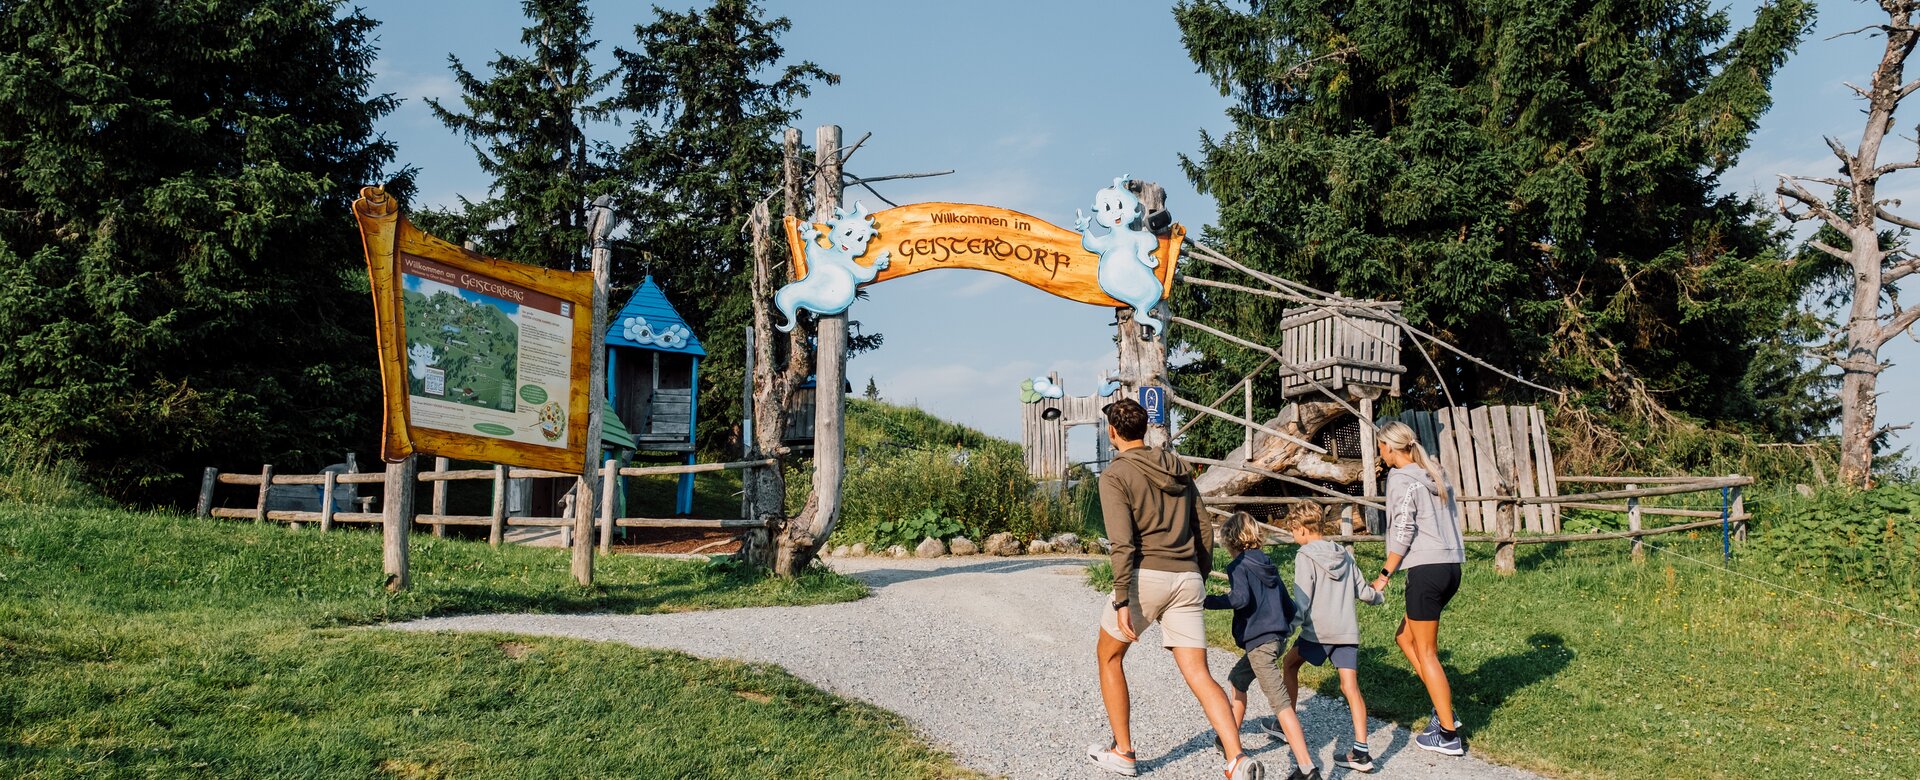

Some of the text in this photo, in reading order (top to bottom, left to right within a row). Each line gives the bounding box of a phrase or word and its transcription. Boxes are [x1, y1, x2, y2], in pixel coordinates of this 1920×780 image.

[931, 212, 1031, 231] Willkommen im
[898, 236, 1071, 280] GEISTERDORF
[404, 258, 524, 303] Willkommen am GEISTERBERG
